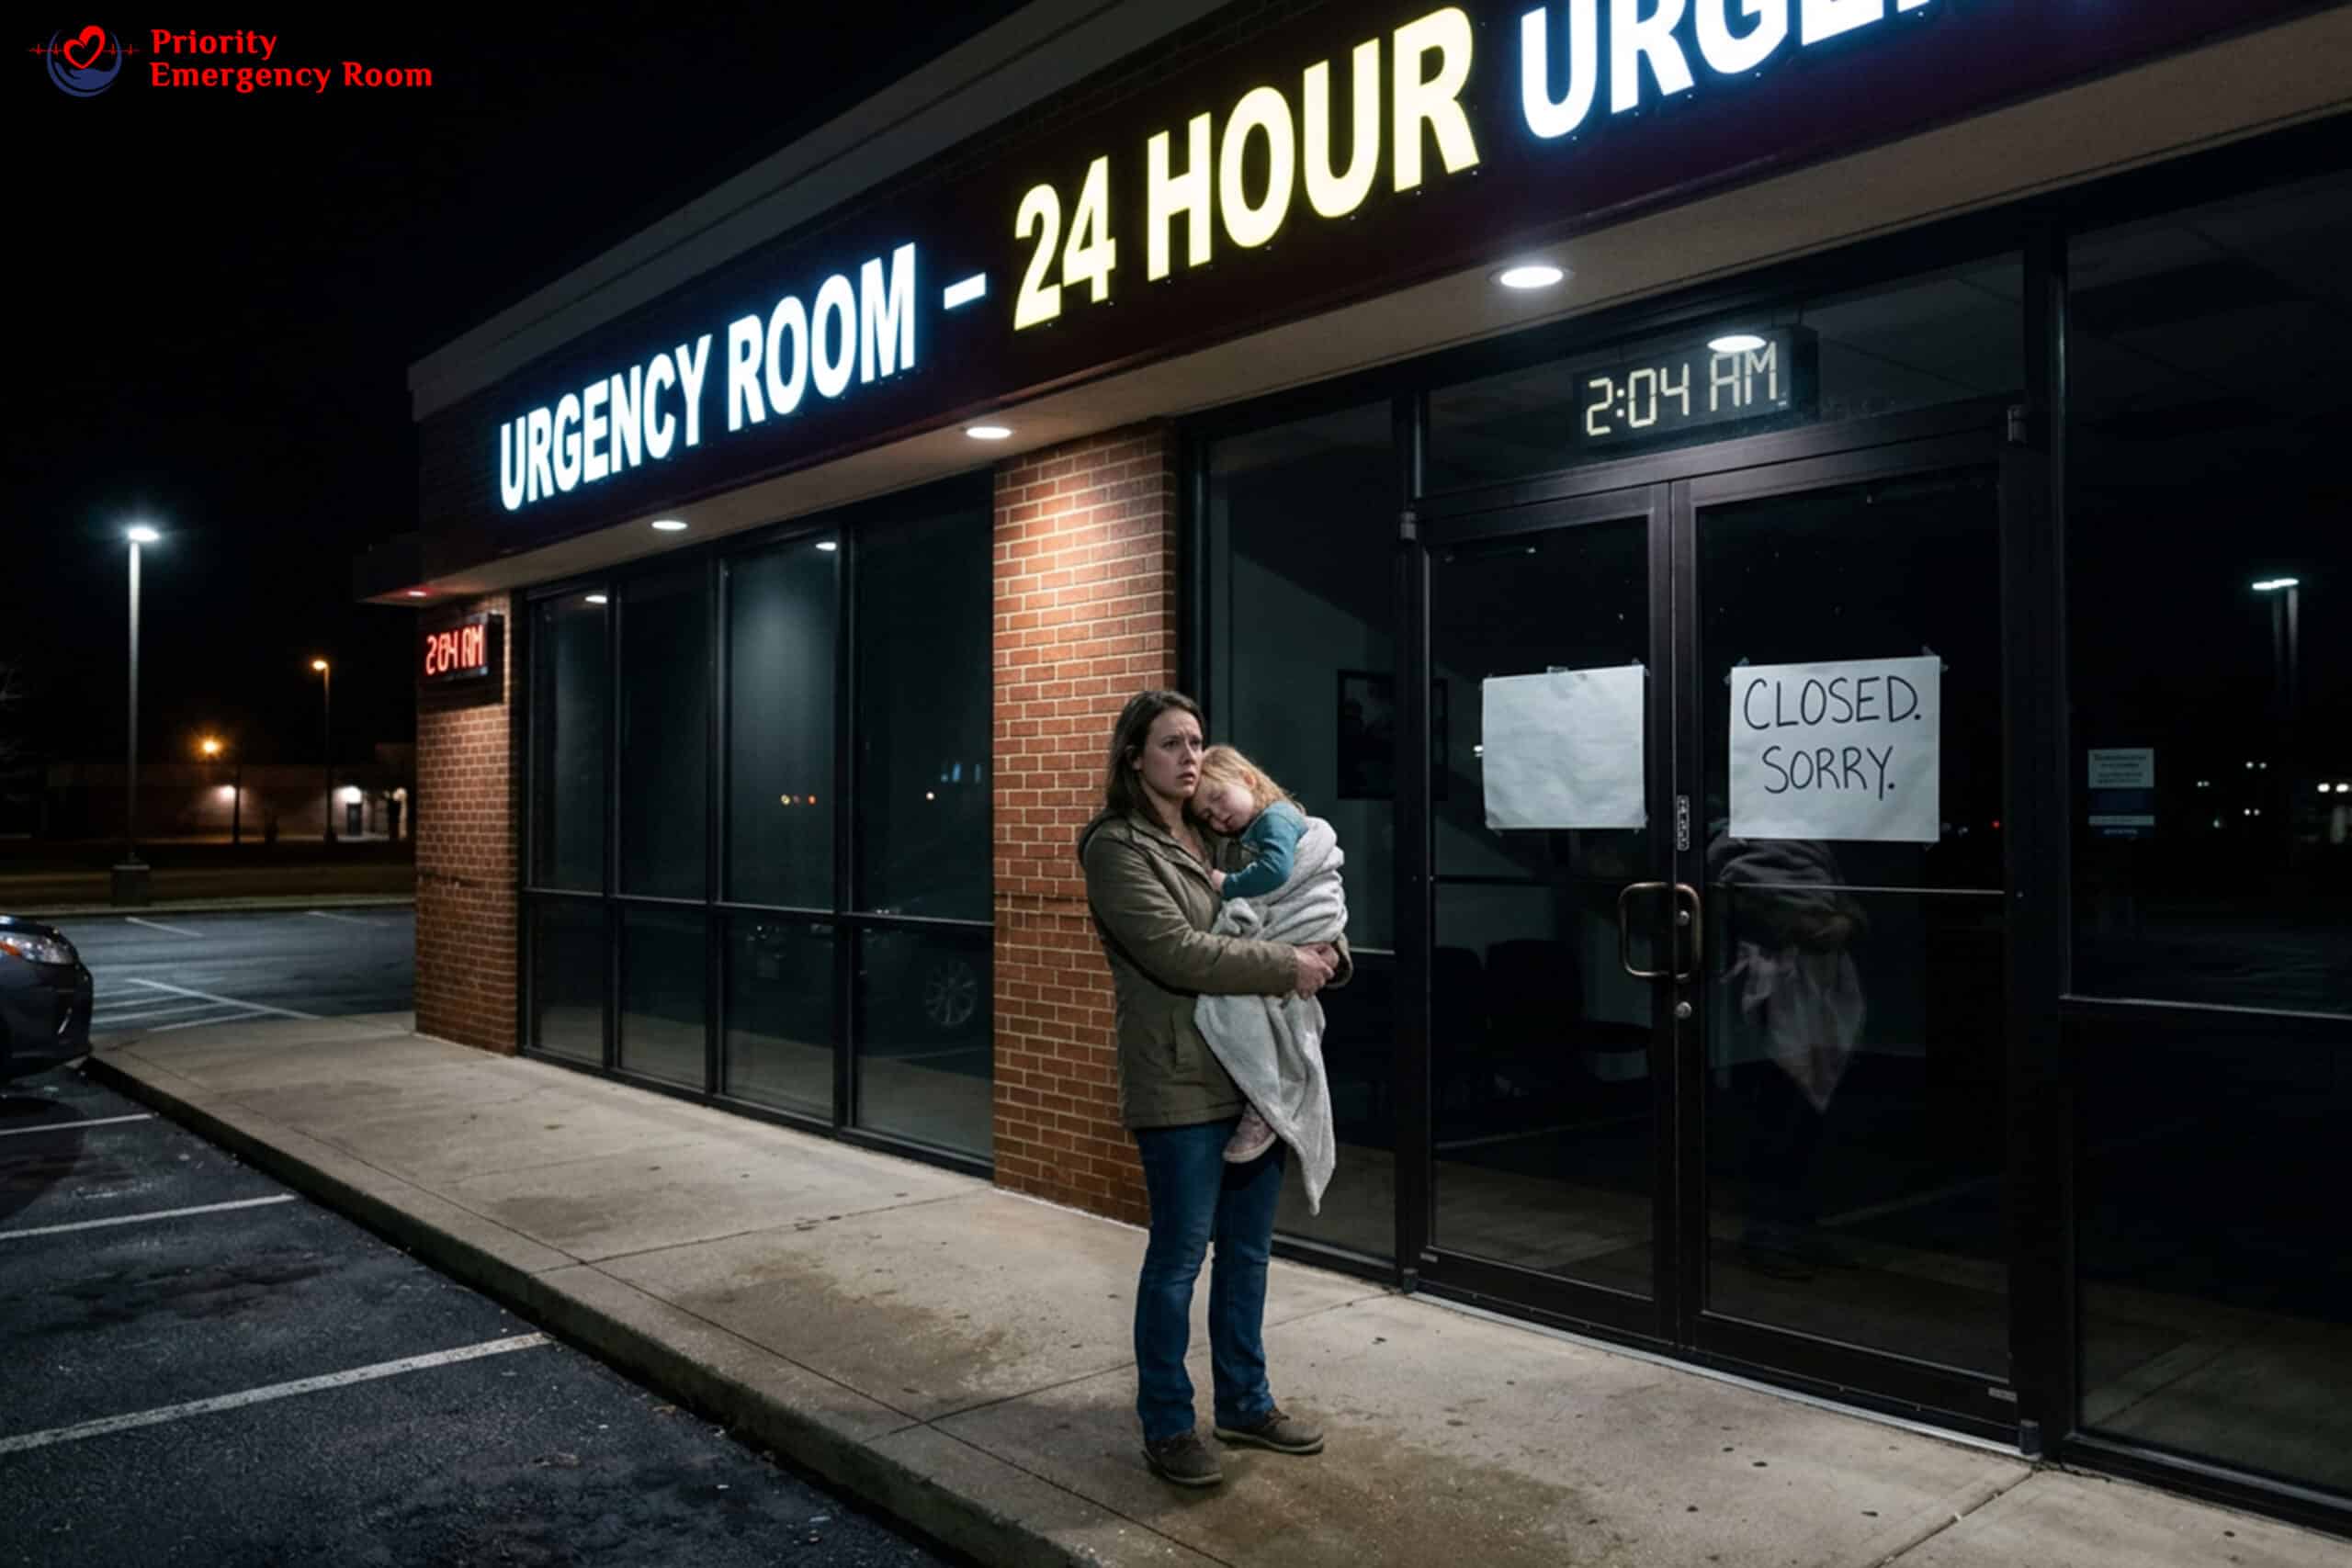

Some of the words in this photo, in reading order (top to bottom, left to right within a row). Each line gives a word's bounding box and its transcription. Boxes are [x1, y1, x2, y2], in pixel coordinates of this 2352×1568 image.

[501, 334, 712, 512] URGENCY
[729, 243, 915, 432] ROOM
[1014, 156, 1116, 330] 24
[1148, 6, 1479, 281] HOUR
[1521, 0, 1929, 138] URG
[1587, 363, 1690, 436] 2:04
[1710, 341, 1778, 412] AM
[1743, 675, 1922, 730] CLOSED.
[1761, 745, 1896, 801] SORRY.
